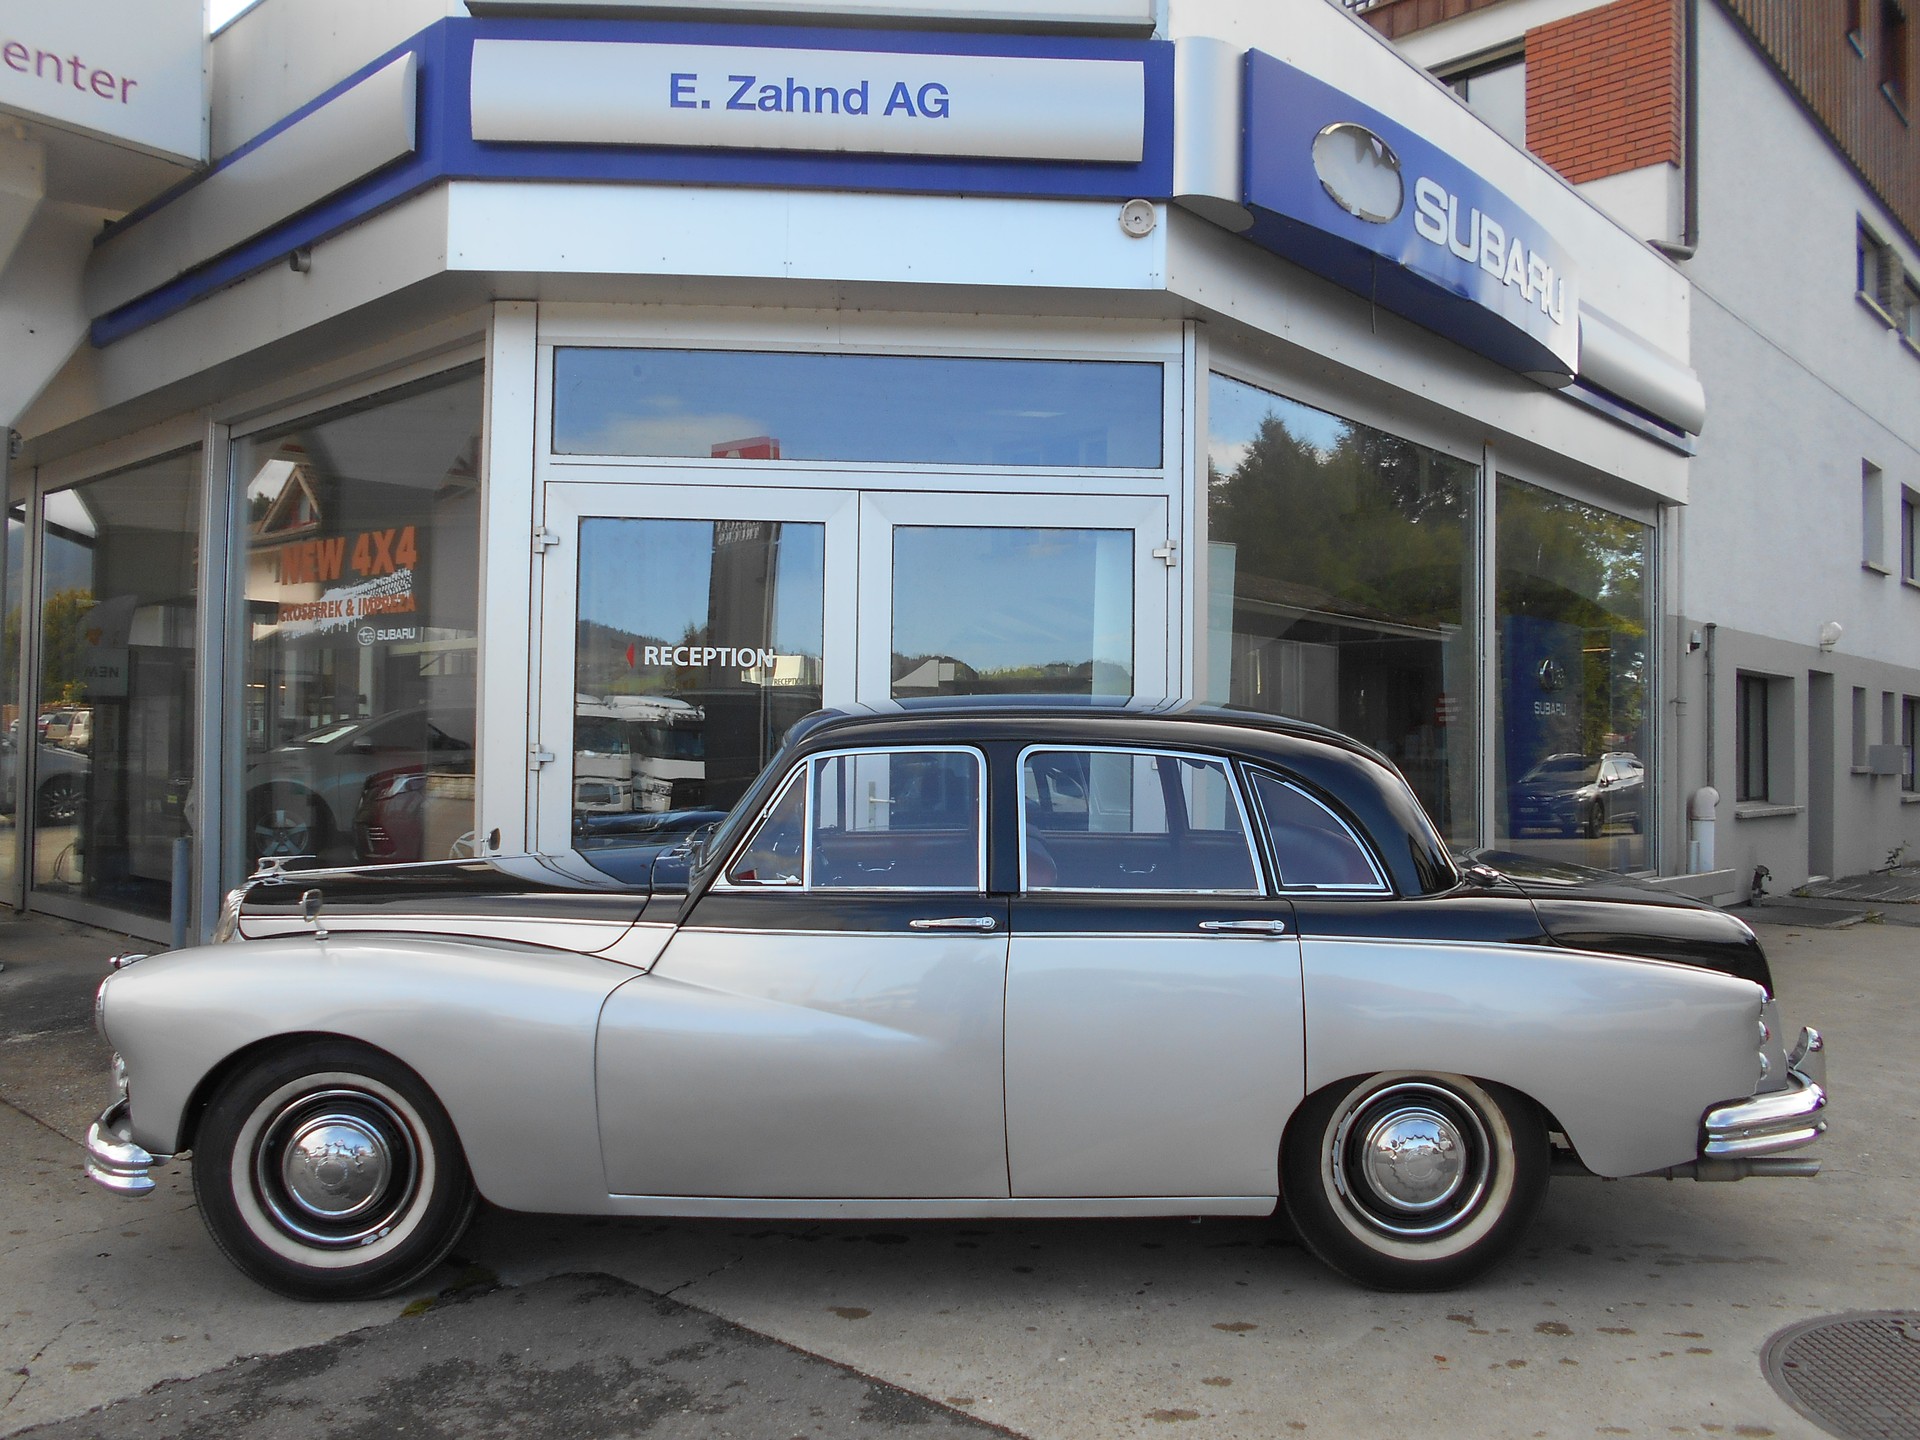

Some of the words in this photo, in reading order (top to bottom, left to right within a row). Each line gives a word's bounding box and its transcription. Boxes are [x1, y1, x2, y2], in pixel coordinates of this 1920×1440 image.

[3, 42, 138, 104] enter
[670, 73, 711, 109] E.
[726, 75, 869, 115] Zahnd
[883, 81, 950, 118] AG
[1414, 177, 1565, 325] SUBARU
[281, 537, 346, 585] NEW
[351, 525, 417, 576] 4X4
[345, 599, 355, 616] &
[376, 627, 416, 641] SUBARU
[643, 646, 774, 668] RECEPTION
[1534, 701, 1567, 716] SUBARU
